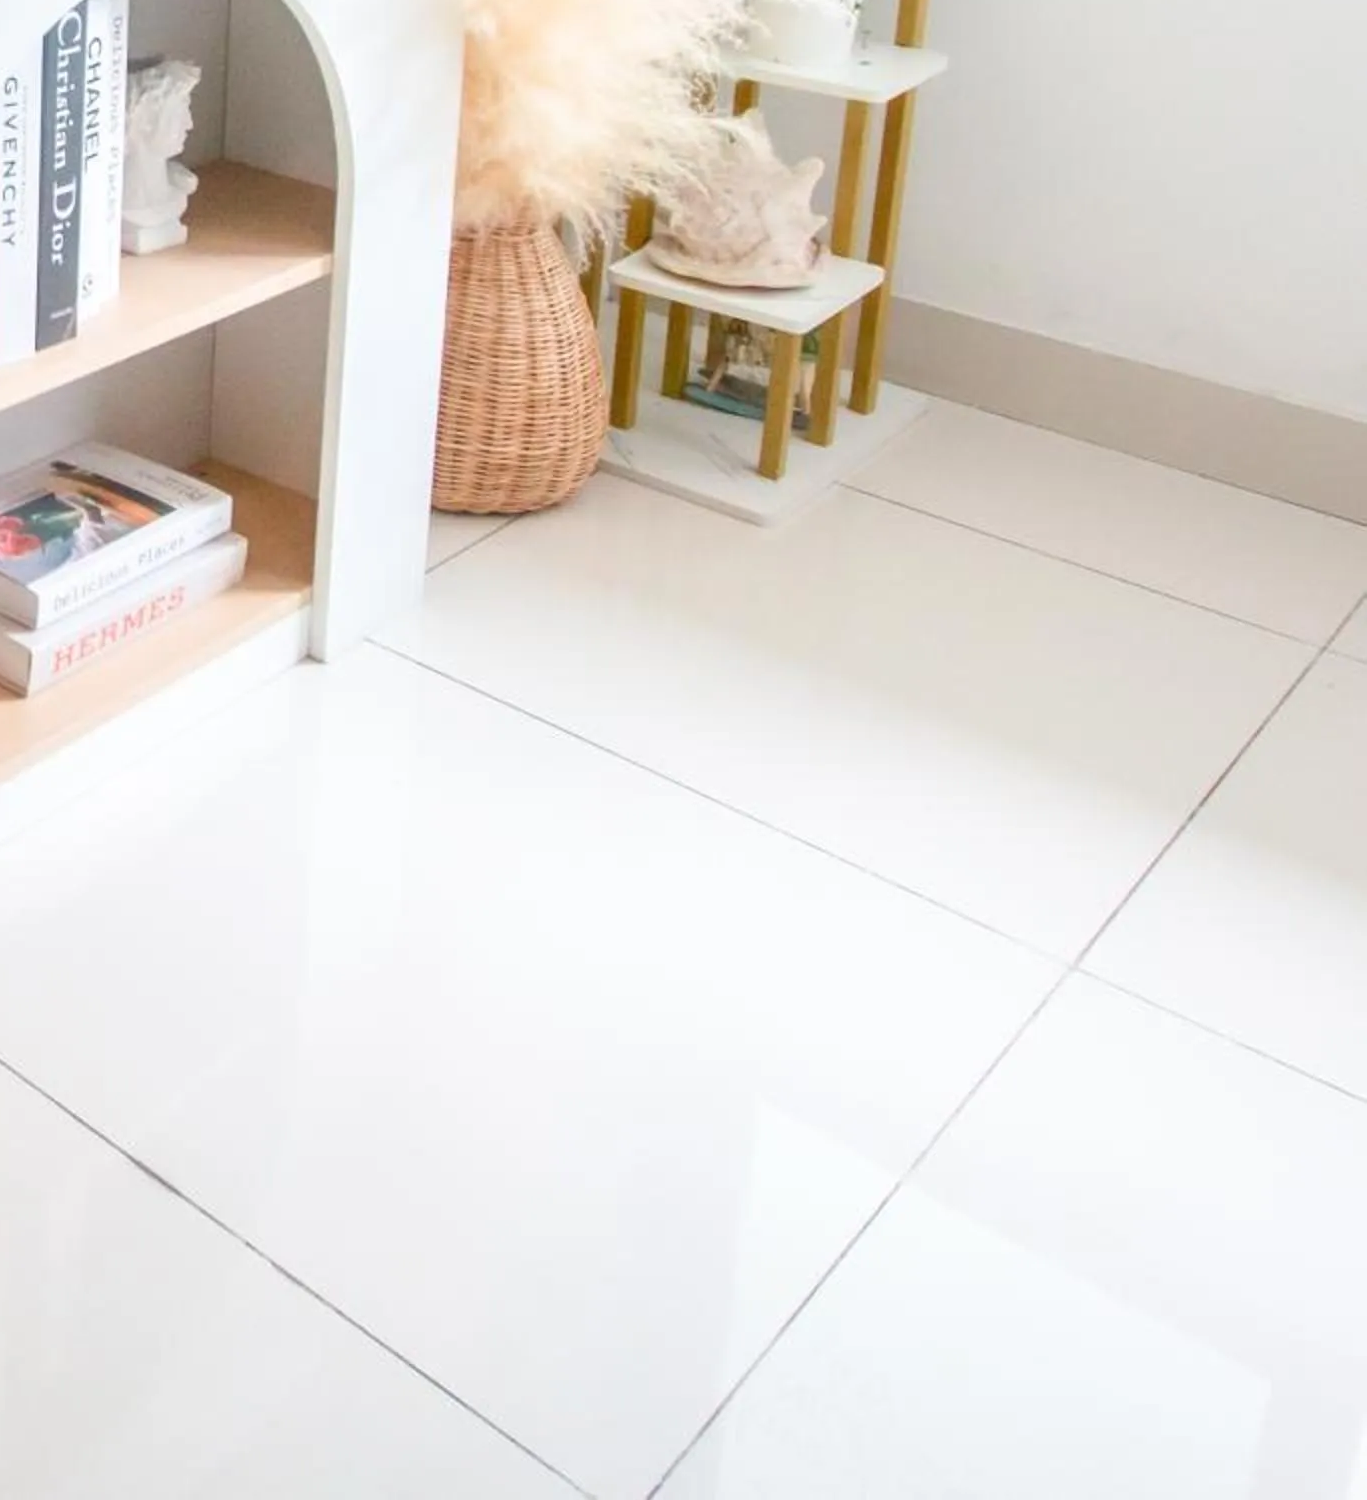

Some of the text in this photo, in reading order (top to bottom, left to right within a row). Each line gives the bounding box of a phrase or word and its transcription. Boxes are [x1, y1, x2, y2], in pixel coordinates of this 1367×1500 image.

[1, 77, 19, 247] GIVENCHY
[50, 12, 82, 267] Christian Dior
[85, 38, 102, 173] CHANEL
[51, 584, 187, 674] HERMES
